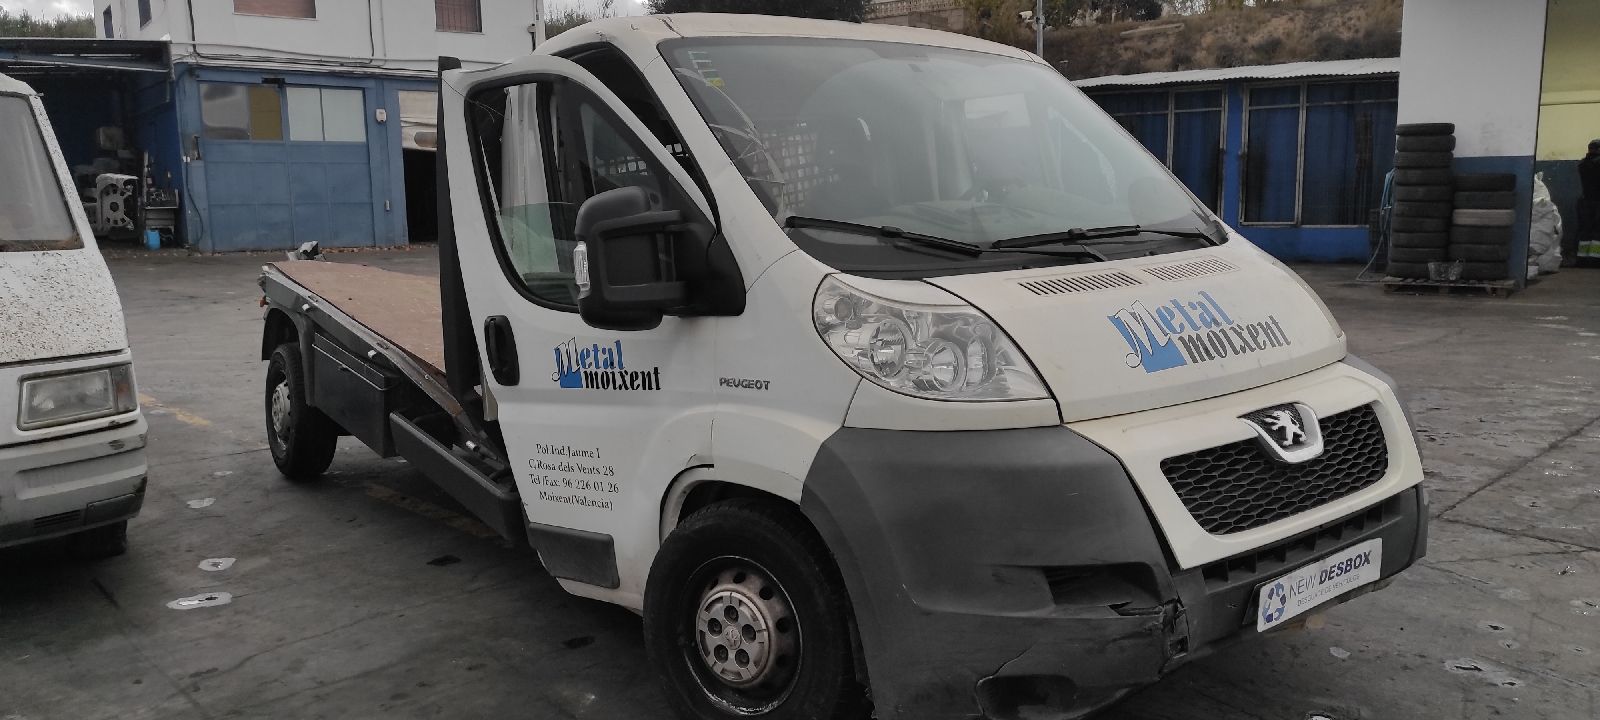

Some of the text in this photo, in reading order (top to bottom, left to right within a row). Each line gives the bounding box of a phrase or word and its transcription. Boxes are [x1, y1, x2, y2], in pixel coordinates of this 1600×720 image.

[1110, 290, 1235, 368] Metal
[1178, 315, 1292, 364] moixent
[552, 337, 625, 380] Metal
[583, 366, 662, 391] moixent
[719, 377, 771, 391] PEUGEOT
[558, 462, 575, 473] dels
[576, 463, 601, 475] Vents
[602, 465, 615, 477] 28
[562, 477, 573, 488] 96
[574, 479, 592, 490] 226
[593, 481, 604, 492] 01
[607, 482, 619, 494] 26
[1289, 550, 1372, 599] NEW DESBOX
